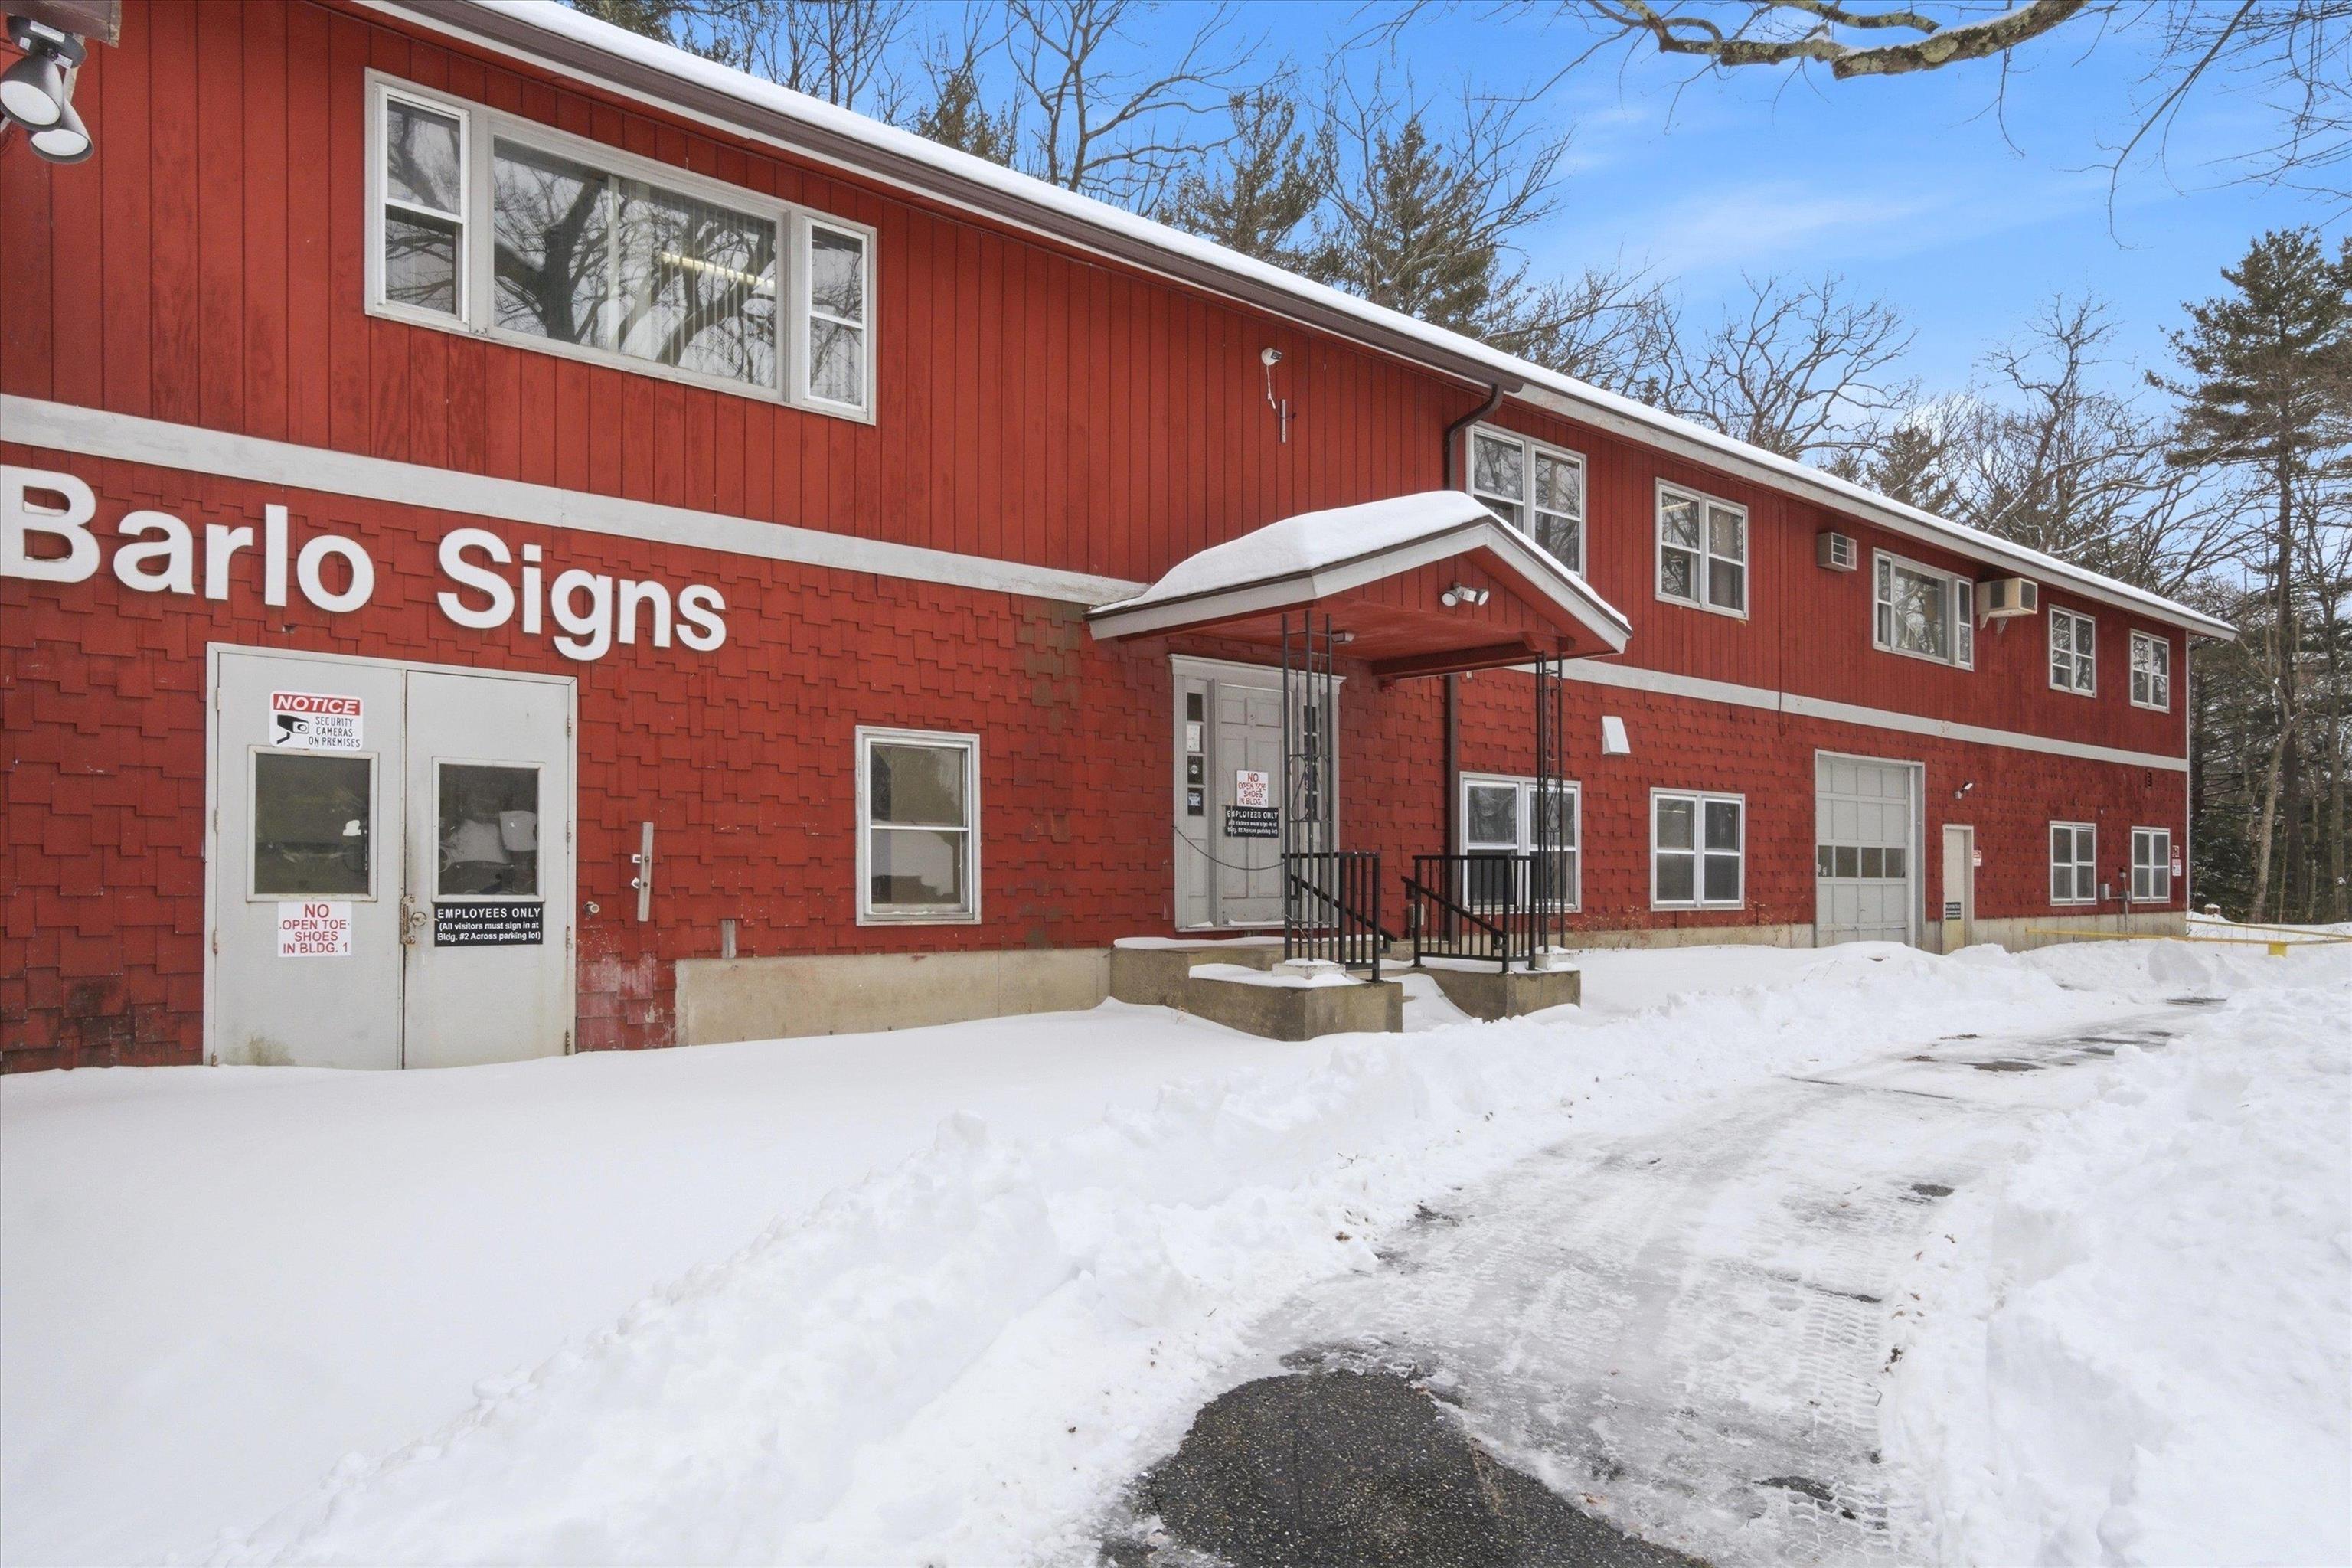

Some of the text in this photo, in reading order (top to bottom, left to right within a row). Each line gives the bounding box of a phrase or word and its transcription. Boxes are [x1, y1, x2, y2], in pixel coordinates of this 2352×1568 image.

[0, 465, 727, 661] Barlo Signs
[276, 695, 358, 714] NOTICE
[315, 716, 354, 727] SECURITY
[316, 727, 353, 737] CAMERAS
[309, 737, 361, 748] ON PREMISES
[1247, 773, 1259, 782] NO
[304, 904, 329, 918] NO
[437, 907, 541, 919] EMPLOYEES ONLY
[282, 920, 347, 930] OPEN TOE
[439, 923, 453, 932] (All
[454, 922, 483, 930] visitors
[505, 921, 521, 931] sign
[295, 931, 338, 942] SHOES
[437, 933, 458, 942] Bldg.
[470, 932, 498, 940] Across
[498, 931, 528, 941] parking
[528, 931, 541, 940] lot)
[283, 942, 348, 954] IN BLDG. 1
